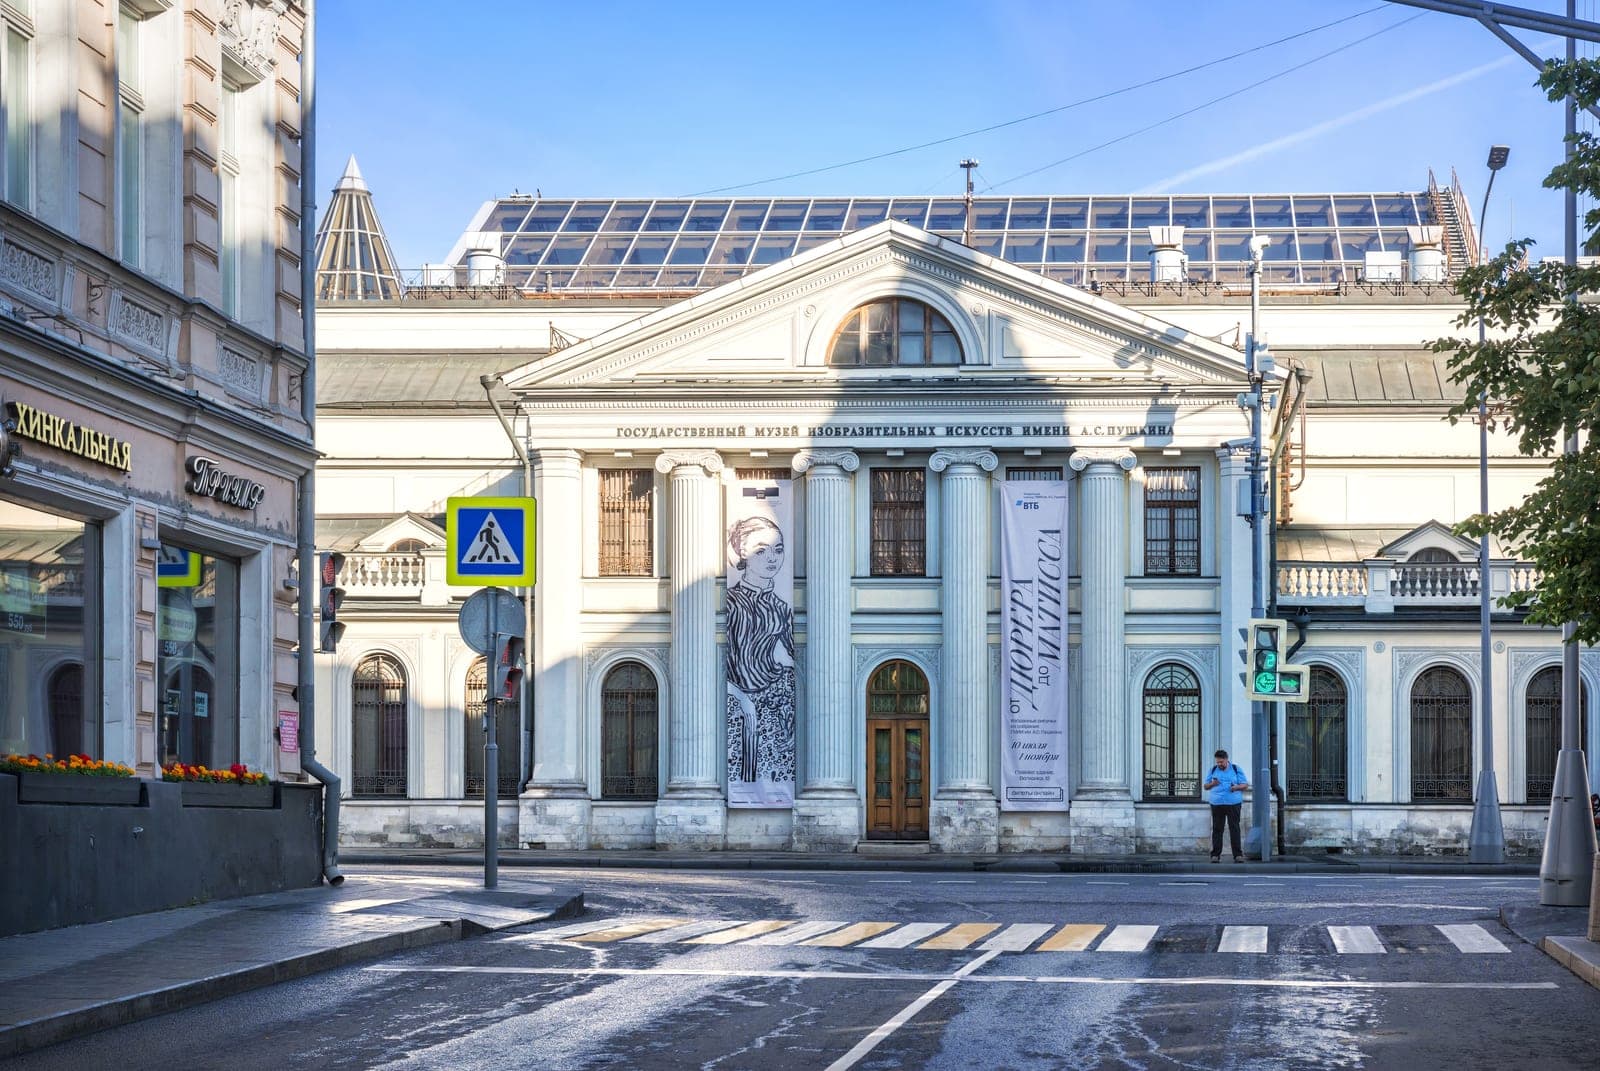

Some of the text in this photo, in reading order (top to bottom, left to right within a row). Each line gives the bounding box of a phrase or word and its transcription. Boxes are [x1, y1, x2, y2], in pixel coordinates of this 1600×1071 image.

[15, 401, 132, 472] ХИНКАЛЬНАЯ
[616, 424, 747, 438] ГОСУДАРСТВЕННЫЙ
[755, 424, 800, 437] МУЗЕЙ
[808, 425, 936, 437] ИЗОБРАЗИТЕЛЬНЫХ
[946, 425, 1013, 437] ИСКУССТВ
[1022, 425, 1071, 437] ИМЕНИ
[1023, 501, 1040, 510] ВТБ
[1037, 529, 1061, 671] МАТИССА
[1010, 578, 1038, 711] ДЮРЕРА
[1024, 752, 1060, 764] ноября
